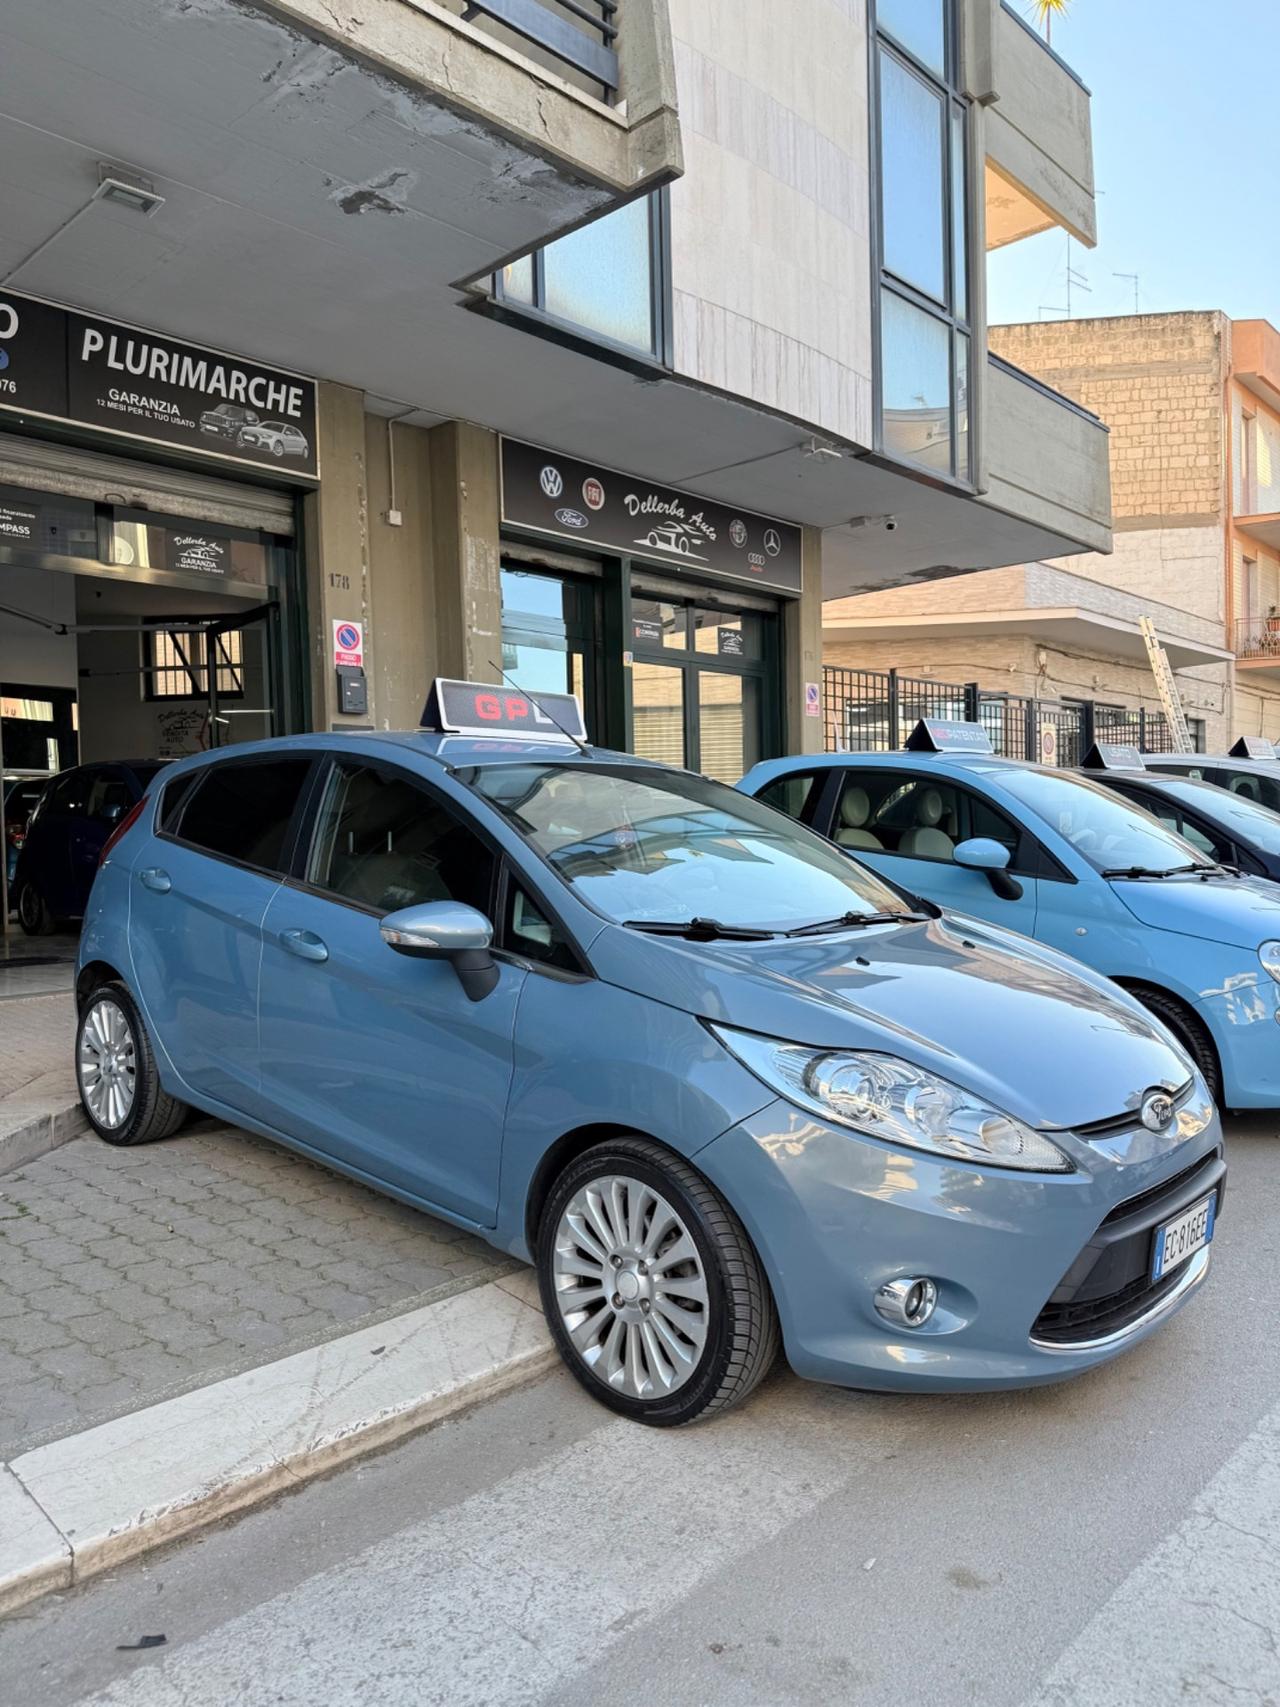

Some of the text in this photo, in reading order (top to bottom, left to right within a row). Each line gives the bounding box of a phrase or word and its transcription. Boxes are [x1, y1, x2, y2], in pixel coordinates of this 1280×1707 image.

[0, 379, 17, 393] 76
[81, 328, 303, 418] PLURIMARCHE
[96, 399, 196, 428] 12 MESI PER IL TUO USATO
[108, 388, 181, 416] GARANZIA
[561, 511, 582, 525] Ford
[624, 494, 685, 518] Dellerba
[688, 512, 717, 541] Auto
[329, 573, 350, 590] 178
[474, 694, 554, 724] GPL
